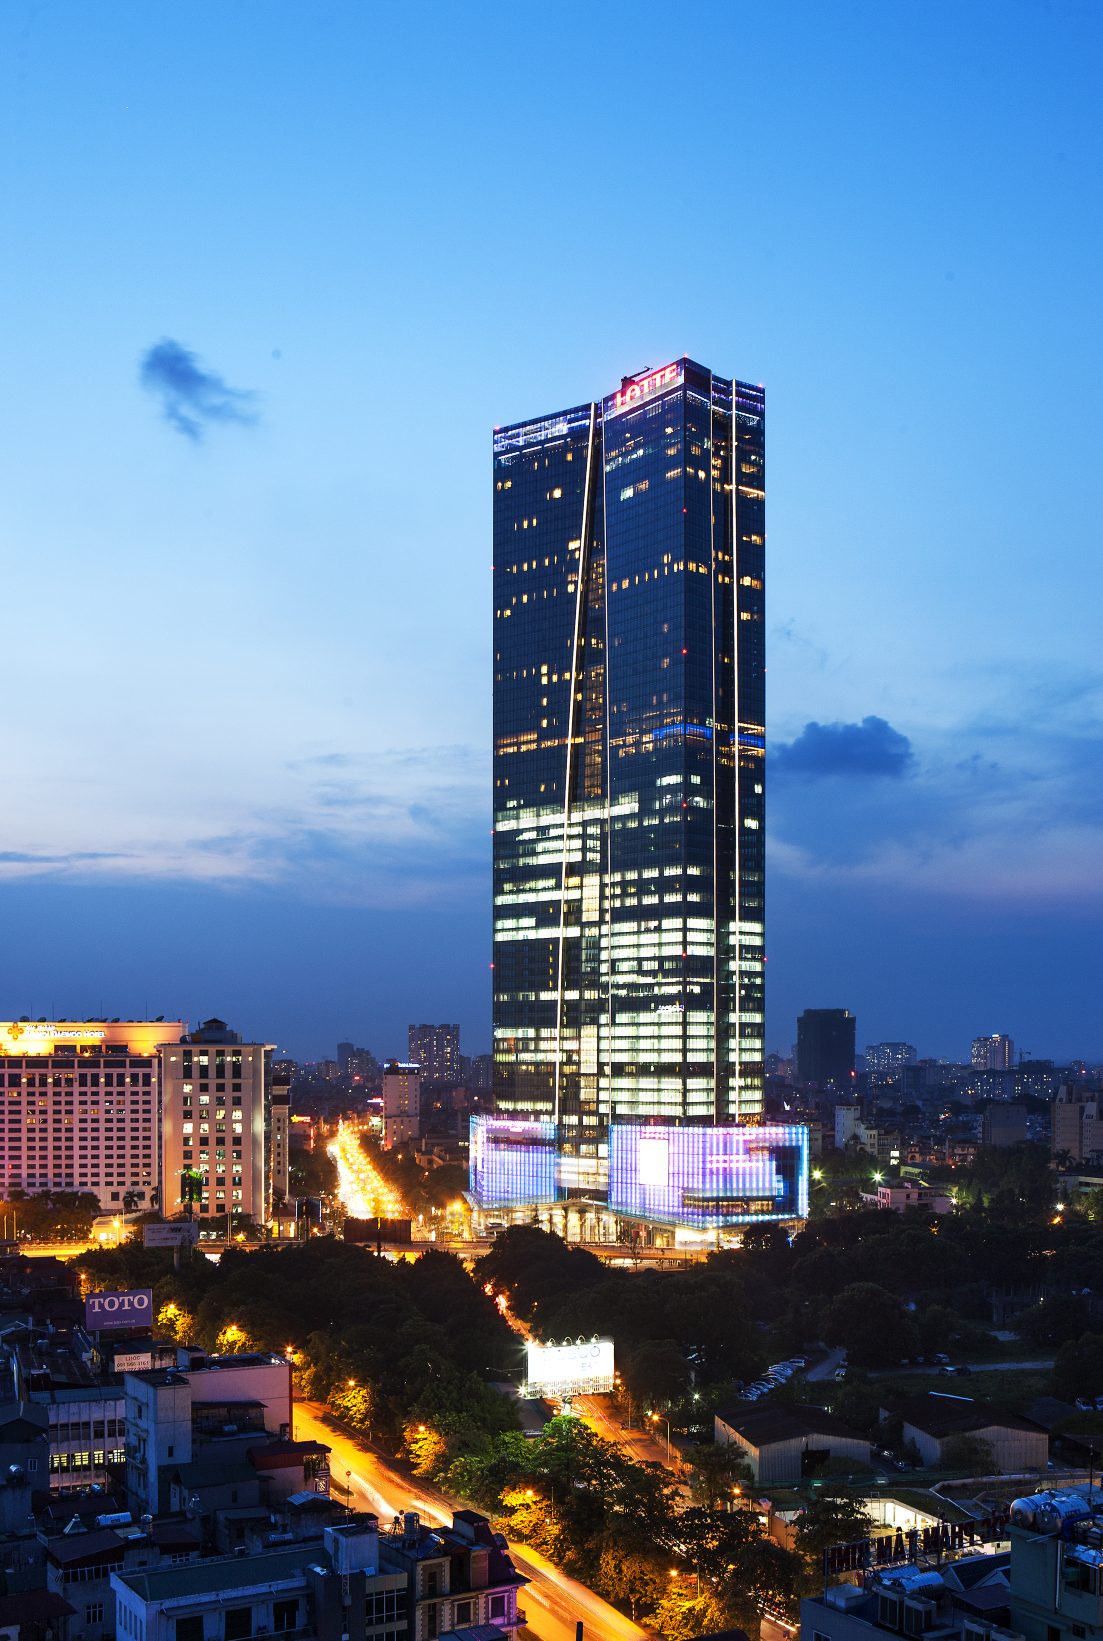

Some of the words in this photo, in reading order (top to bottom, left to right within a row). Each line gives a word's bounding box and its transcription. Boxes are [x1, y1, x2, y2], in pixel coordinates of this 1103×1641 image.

[616, 364, 677, 410] LOTTE
[51, 1030, 82, 1038] DAEWOO
[84, 1030, 106, 1038] HOTEL
[89, 1294, 149, 1313] TOTO
